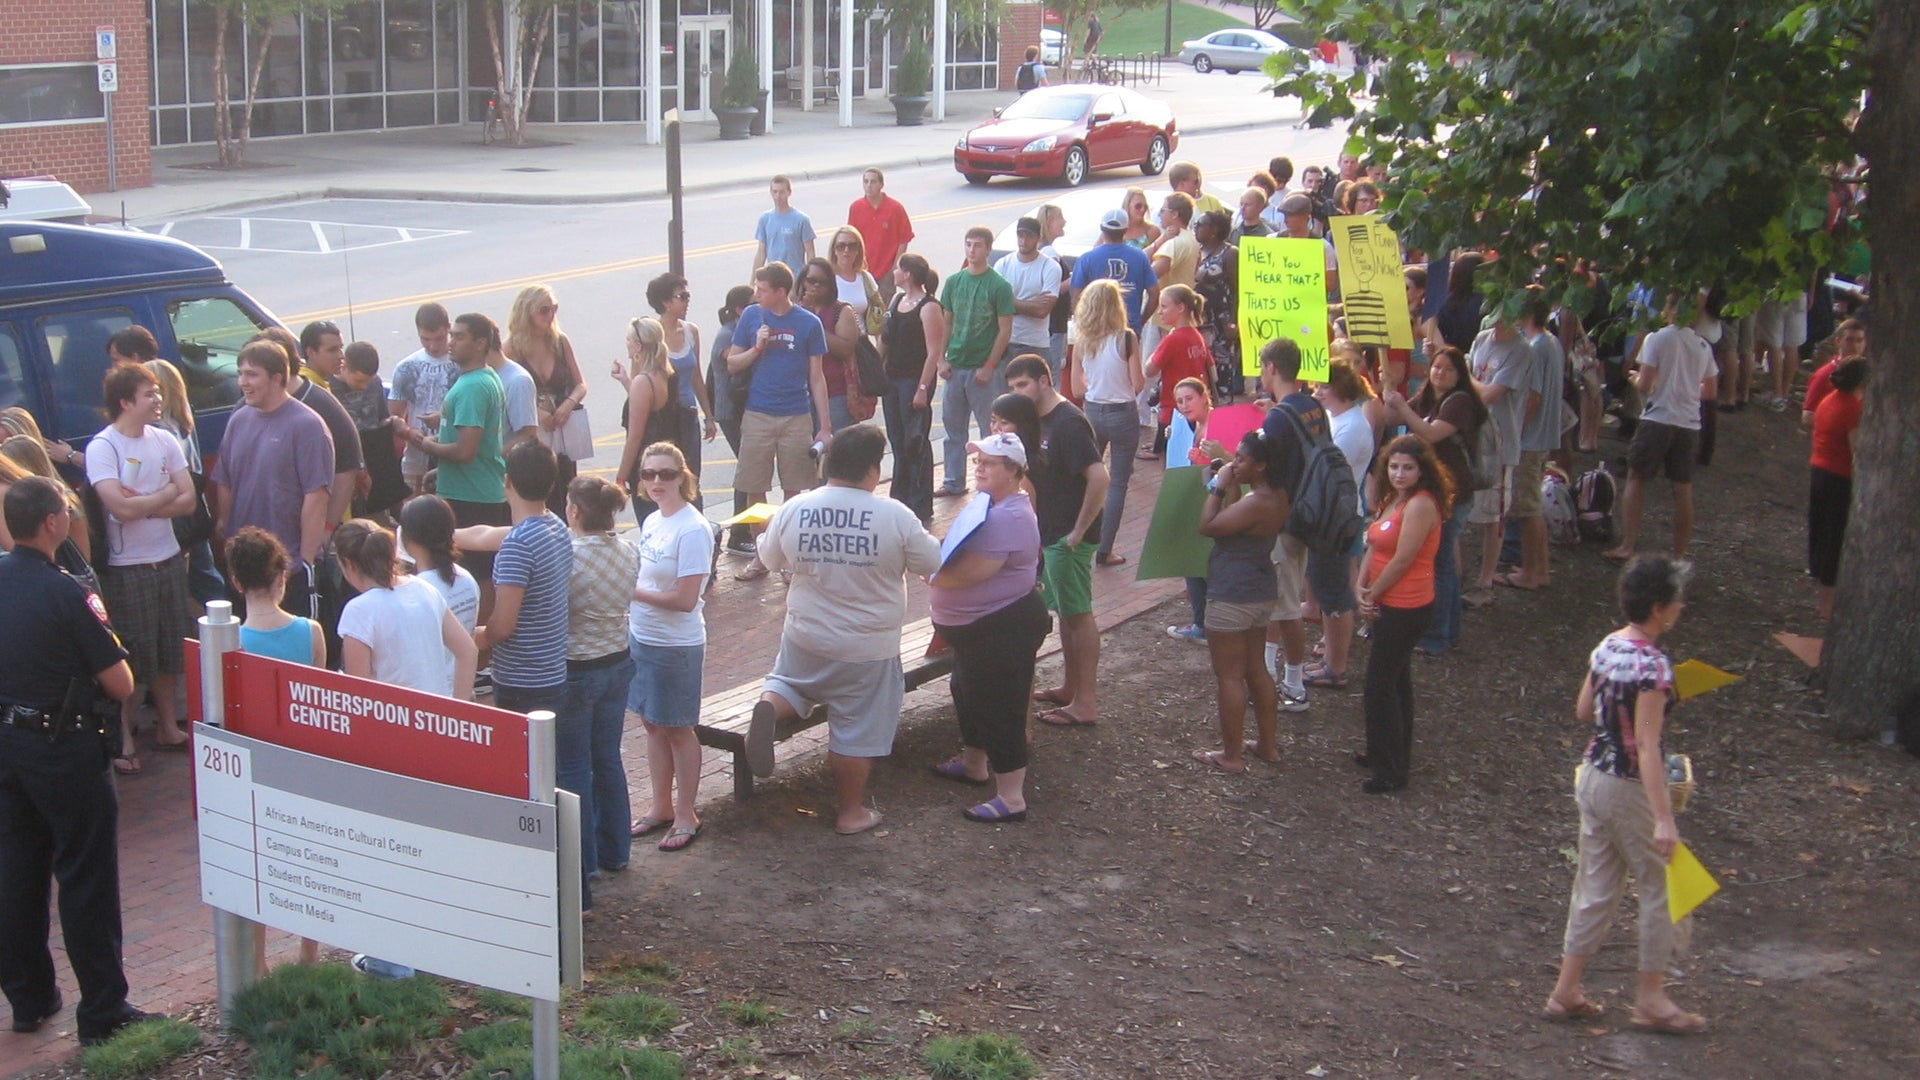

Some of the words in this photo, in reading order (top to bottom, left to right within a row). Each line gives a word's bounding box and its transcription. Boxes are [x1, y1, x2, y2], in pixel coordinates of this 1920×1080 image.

[1247, 245, 1275, 267] HEY,
[1255, 270, 1282, 284] HEAR
[1286, 272, 1320, 286] THAT?
[1283, 297, 1301, 311] US
[1247, 316, 1283, 340] NOT
[799, 507, 873, 531] PADDLE
[798, 533, 879, 556] FASTER!
[288, 681, 409, 727] WITHERSPOON
[415, 709, 493, 746] STUDENT
[289, 703, 350, 735] CENTER
[203, 745, 241, 778] 2810
[265, 806, 298, 825] African
[301, 816, 346, 838] American
[348, 828, 386, 848] Cultural
[389, 838, 423, 858] Center
[519, 816, 541, 834] 081
[266, 837, 302, 857] Campus
[304, 848, 339, 868] Cinema
[267, 864, 302, 886] Student
[304, 875, 362, 903] Government
[269, 892, 304, 914] Student
[306, 903, 335, 923] Media
